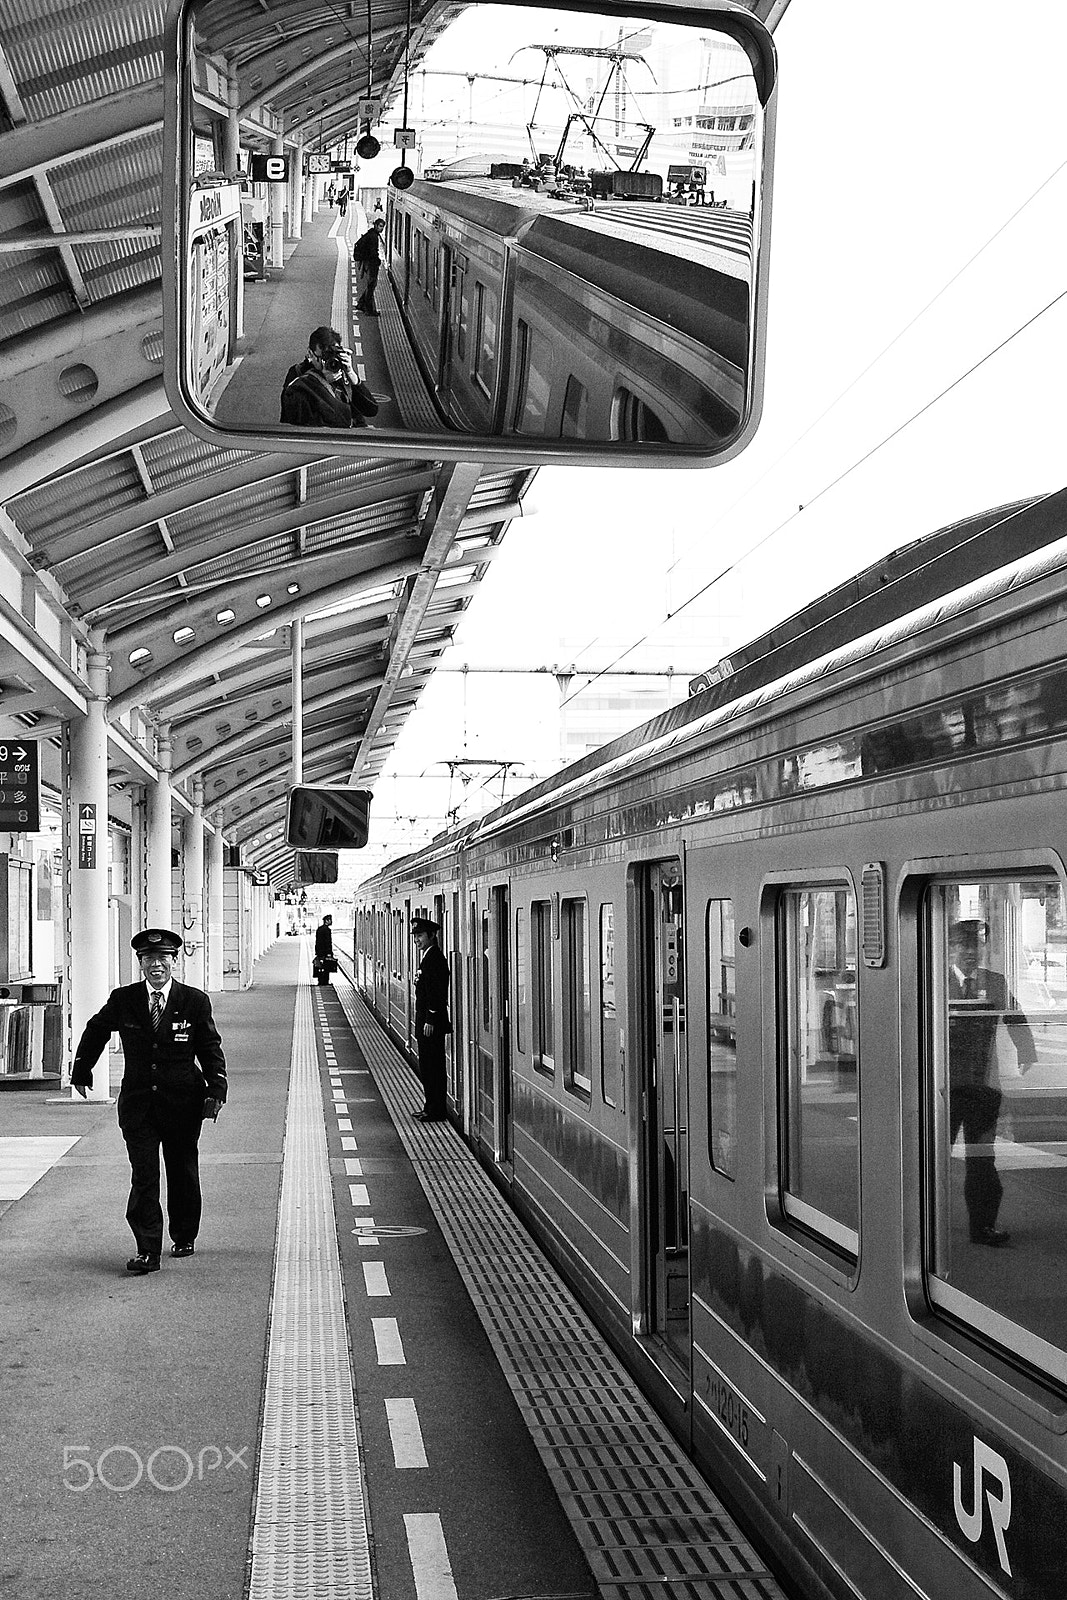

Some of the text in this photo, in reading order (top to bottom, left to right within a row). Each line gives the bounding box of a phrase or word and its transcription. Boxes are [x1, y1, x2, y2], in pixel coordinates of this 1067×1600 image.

[0, 745, 8, 762] 9
[17, 772, 28, 785] 9
[18, 809, 28, 823] 8
[953, 1435, 1012, 1578] JR
